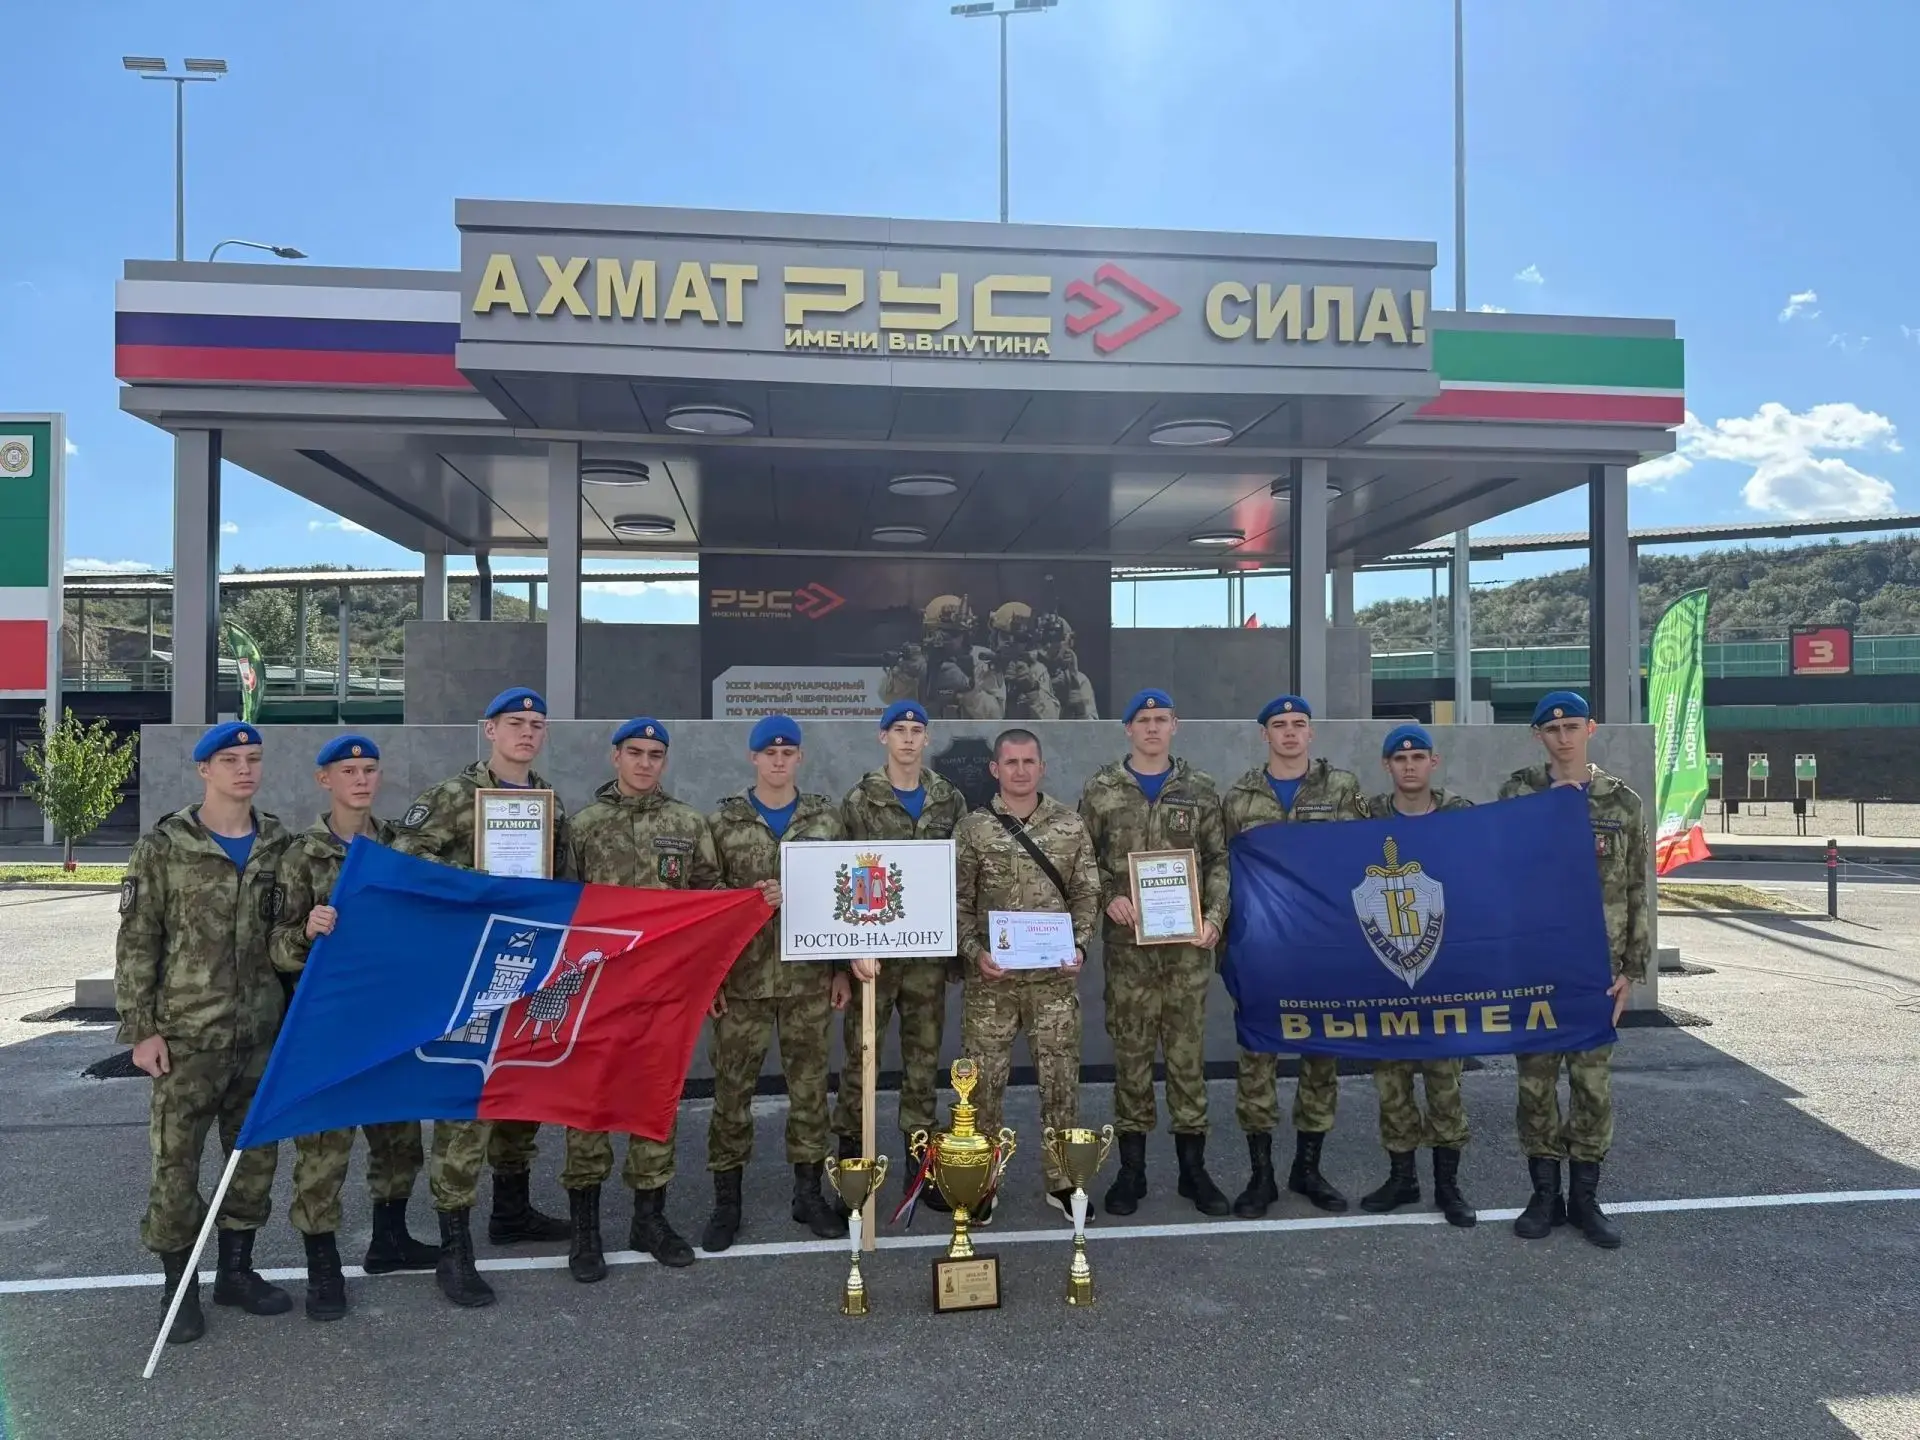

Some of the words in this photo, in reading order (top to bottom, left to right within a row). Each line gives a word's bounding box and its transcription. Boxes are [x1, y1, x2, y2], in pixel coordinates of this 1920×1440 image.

[472, 254, 758, 324] АХМАТ
[784, 266, 1051, 333] РУС
[1205, 281, 1426, 344] СИЛА!
[784, 328, 878, 350] ИМЕНИ
[711, 589, 793, 609] РУС
[1809, 640, 1834, 664] 3
[754, 679, 865, 691] МЕЖДУНАРОДНЫЙ
[725, 692, 793, 703] ОТКРЫТЫЙ
[796, 694, 867, 703] ЧЕМПИОНАТ
[725, 707, 743, 716] ПО
[746, 705, 828, 716] ТАКТИЧЕСКОЙ
[488, 820, 538, 829] ГРАМОТА
[1141, 877, 1185, 888] ГРАМОТА
[794, 931, 944, 948] РОСТОВ-НА-ДОНУ
[1025, 925, 1059, 933] ДИПЛОМ
[1403, 920, 1441, 968] ВЫМПЕЛ
[1279, 988, 1497, 1009] ВОЕННО-ПАТРИОТИЧЕСКИЙ
[1502, 984, 1555, 1000] ЦЕНТР
[1280, 1000, 1558, 1040] ВЫМПЕЛ
